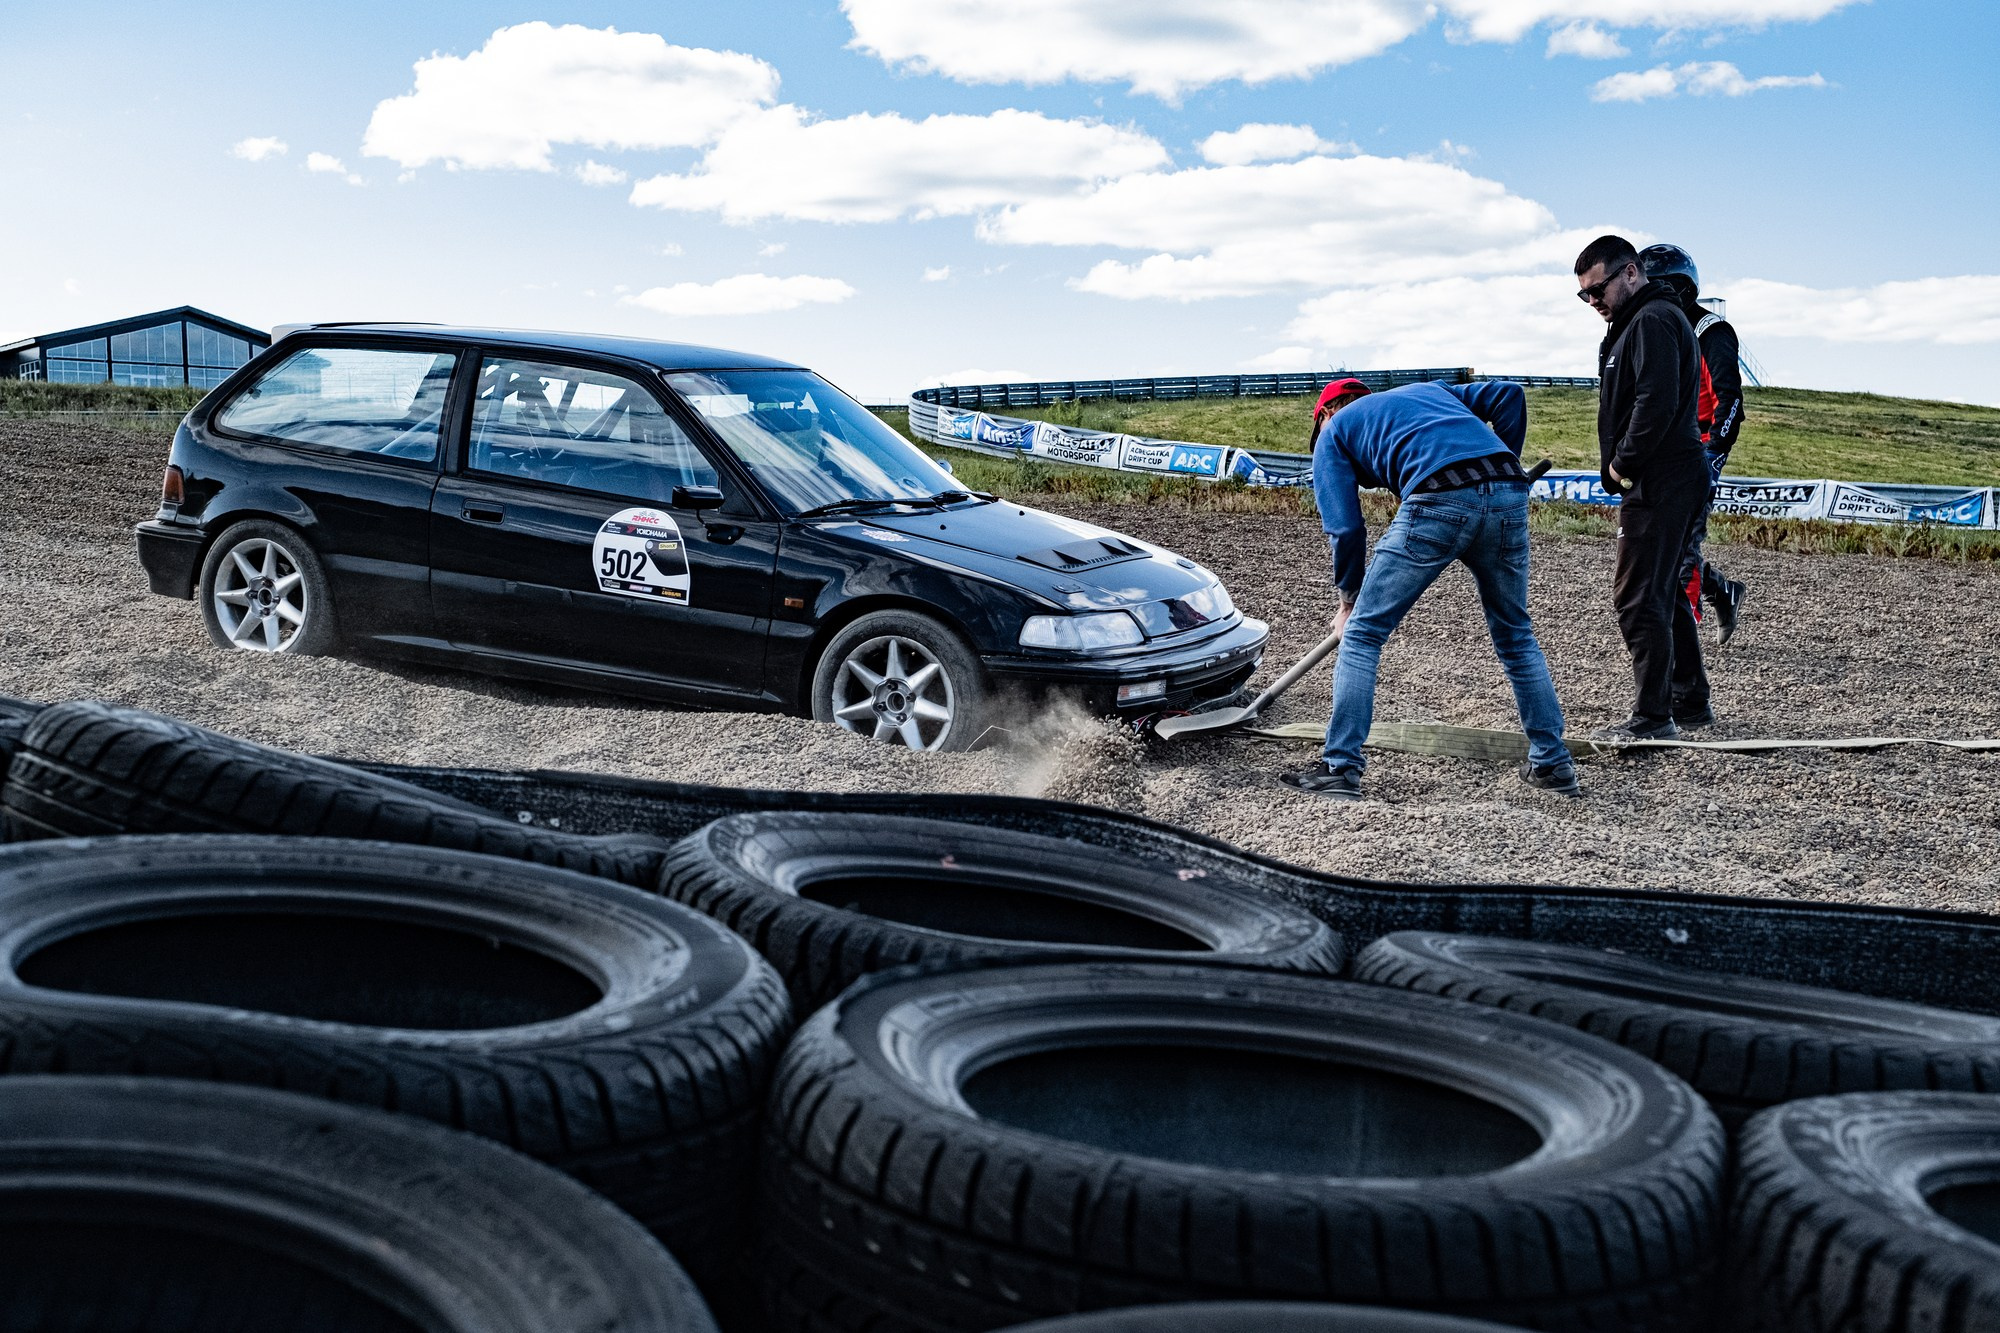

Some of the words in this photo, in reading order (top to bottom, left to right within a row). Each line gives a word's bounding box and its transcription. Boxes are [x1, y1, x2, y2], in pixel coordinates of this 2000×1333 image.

[1047, 447, 1102, 463] MOTORSPORT
[1128, 455, 1146, 463] DRIFT
[1173, 453, 1213, 469] ADC
[1839, 503, 1872, 512] DRIFT
[1874, 506, 1897, 514] CUP
[636, 528, 667, 538] YOKOHAMA
[601, 547, 647, 581] 502
